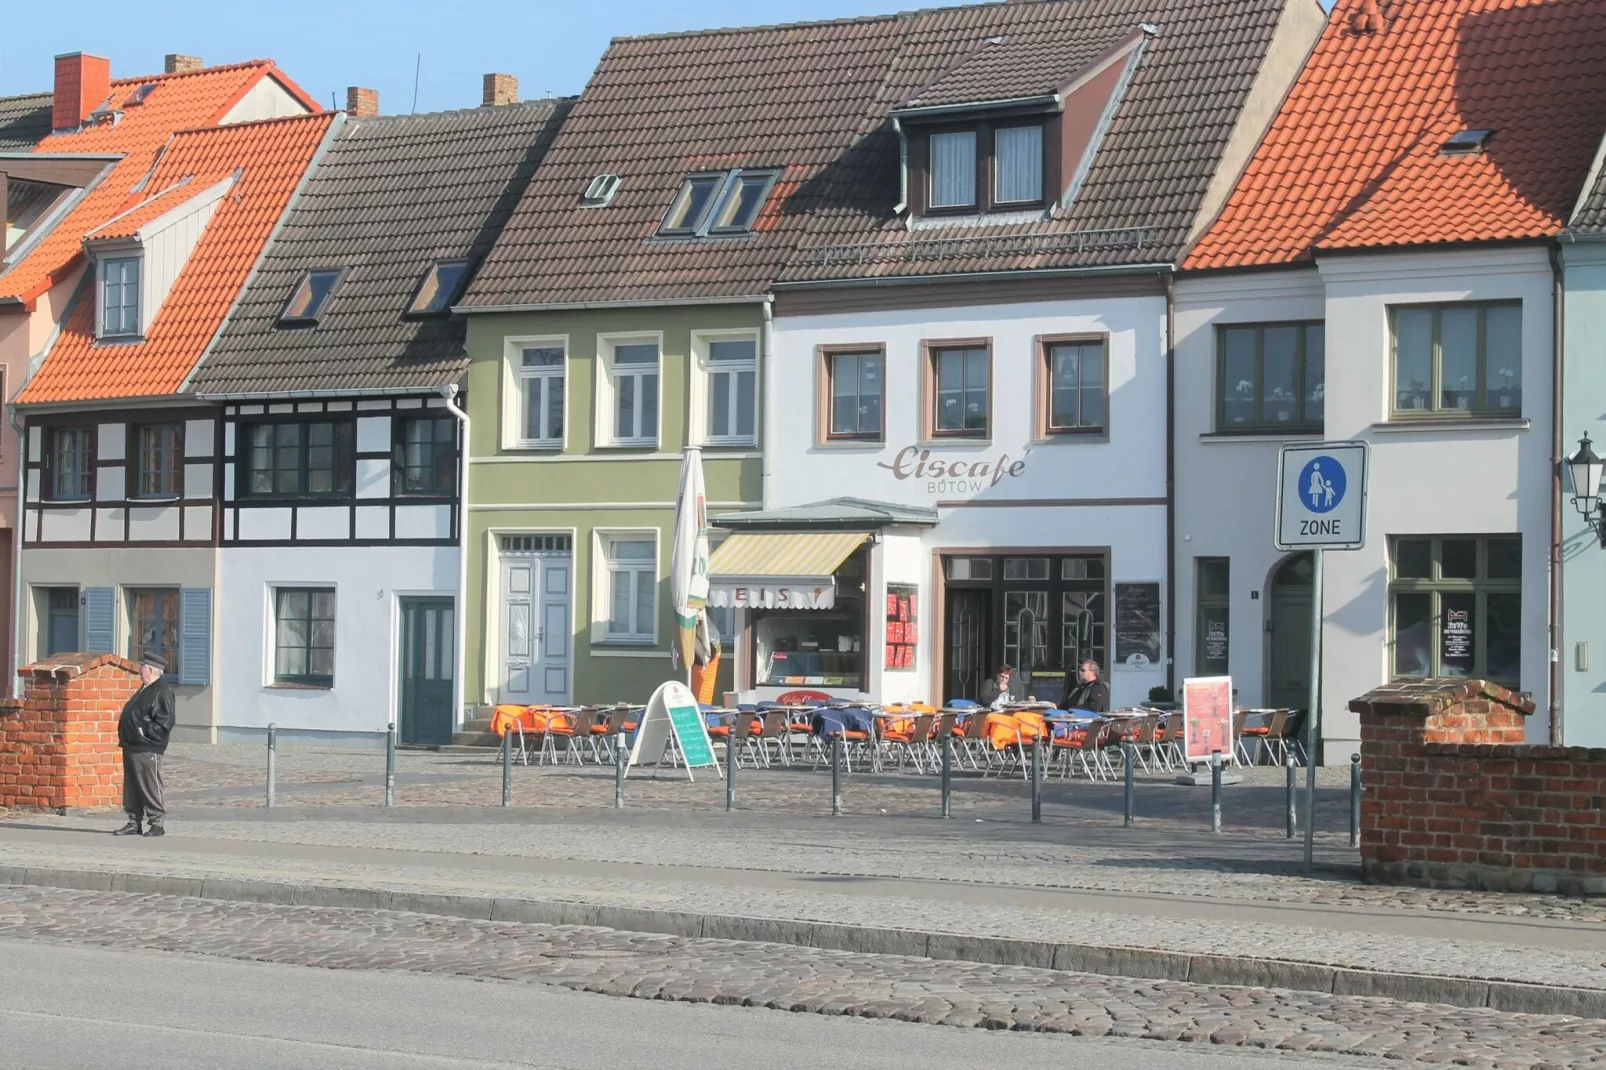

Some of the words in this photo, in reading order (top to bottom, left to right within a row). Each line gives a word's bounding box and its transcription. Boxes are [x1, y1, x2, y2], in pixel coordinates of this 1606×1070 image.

[876, 445, 1031, 487] Eiscafé
[1300, 519, 1341, 535] ZONE
[735, 587, 789, 602] EIS
